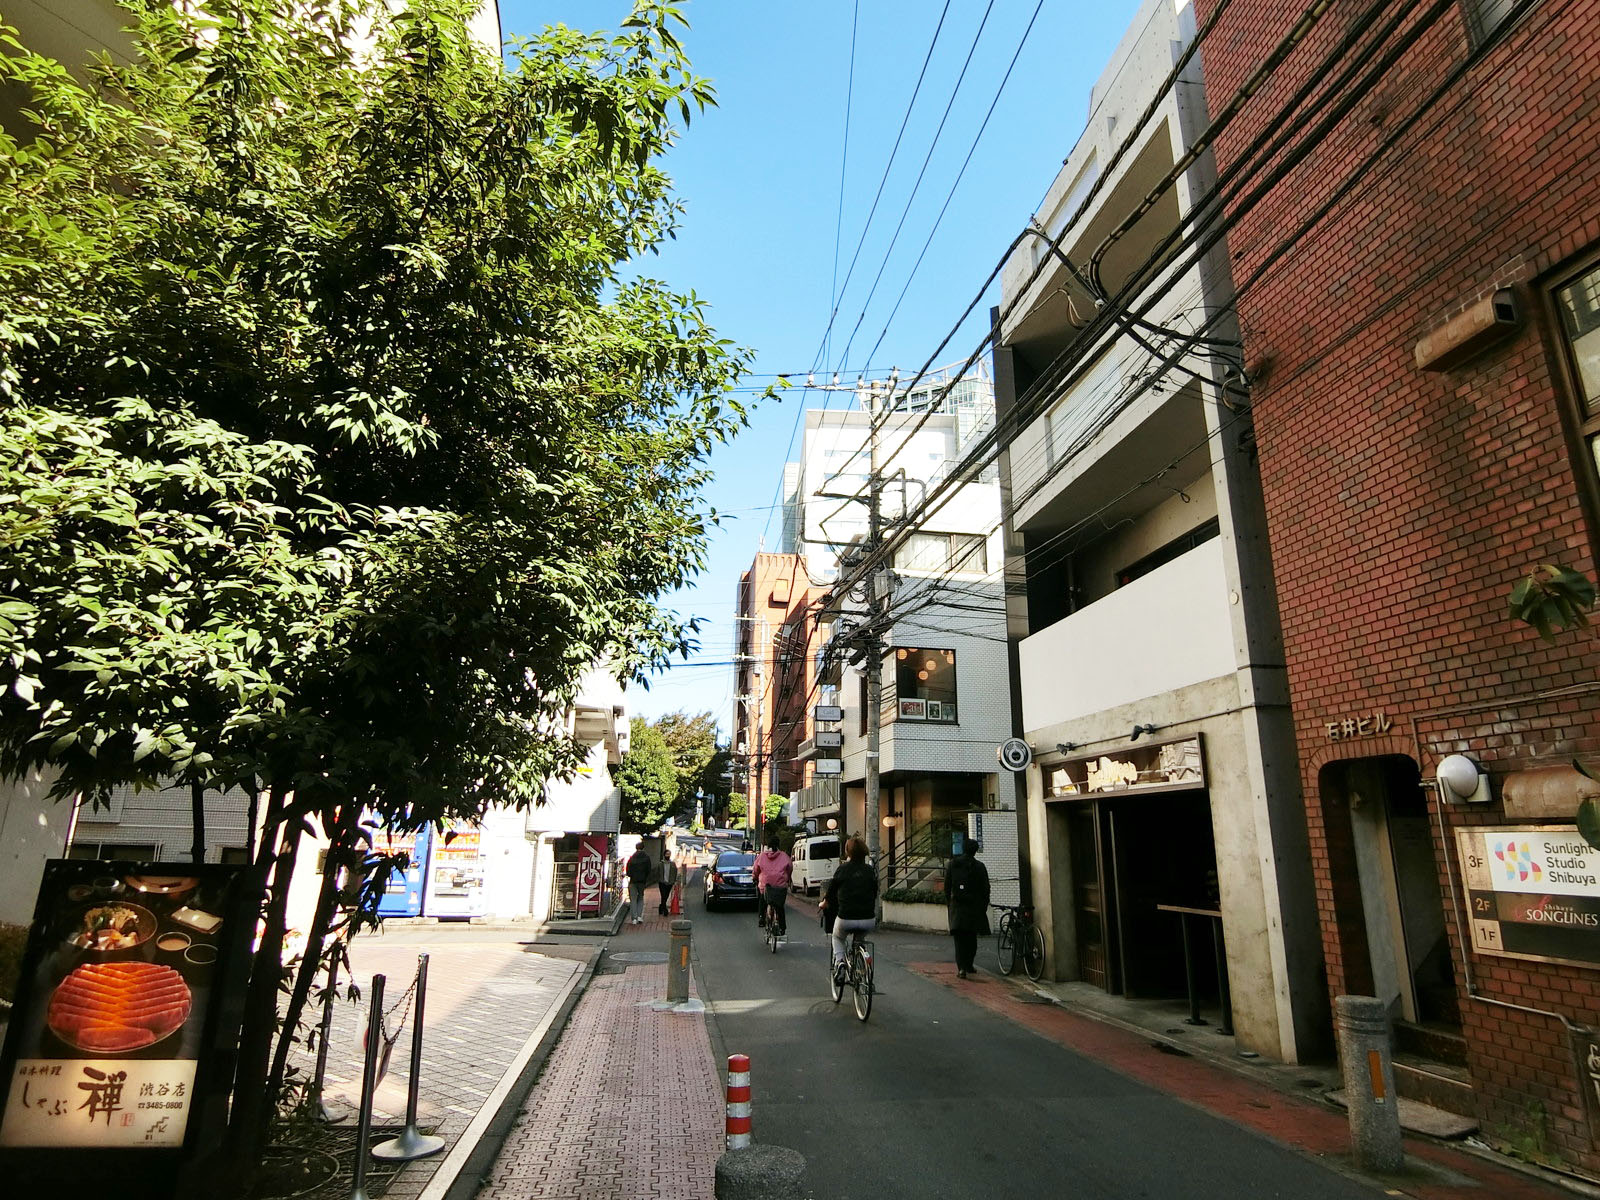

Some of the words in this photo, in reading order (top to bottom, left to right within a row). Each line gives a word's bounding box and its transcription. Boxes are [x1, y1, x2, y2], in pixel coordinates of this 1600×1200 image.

[1325, 713, 1391, 740] 石井ビル
[1544, 842, 1593, 856] Sunlight
[1469, 855, 1483, 868] 3F
[1546, 857, 1586, 869] Studio
[1549, 871, 1596, 886] Shibuya
[1476, 898, 1490, 911] 2F
[1526, 909, 1598, 926] SONGLINES
[1480, 928, 1495, 941] 1F
[139, 1082, 186, 1097] 渋谷店
